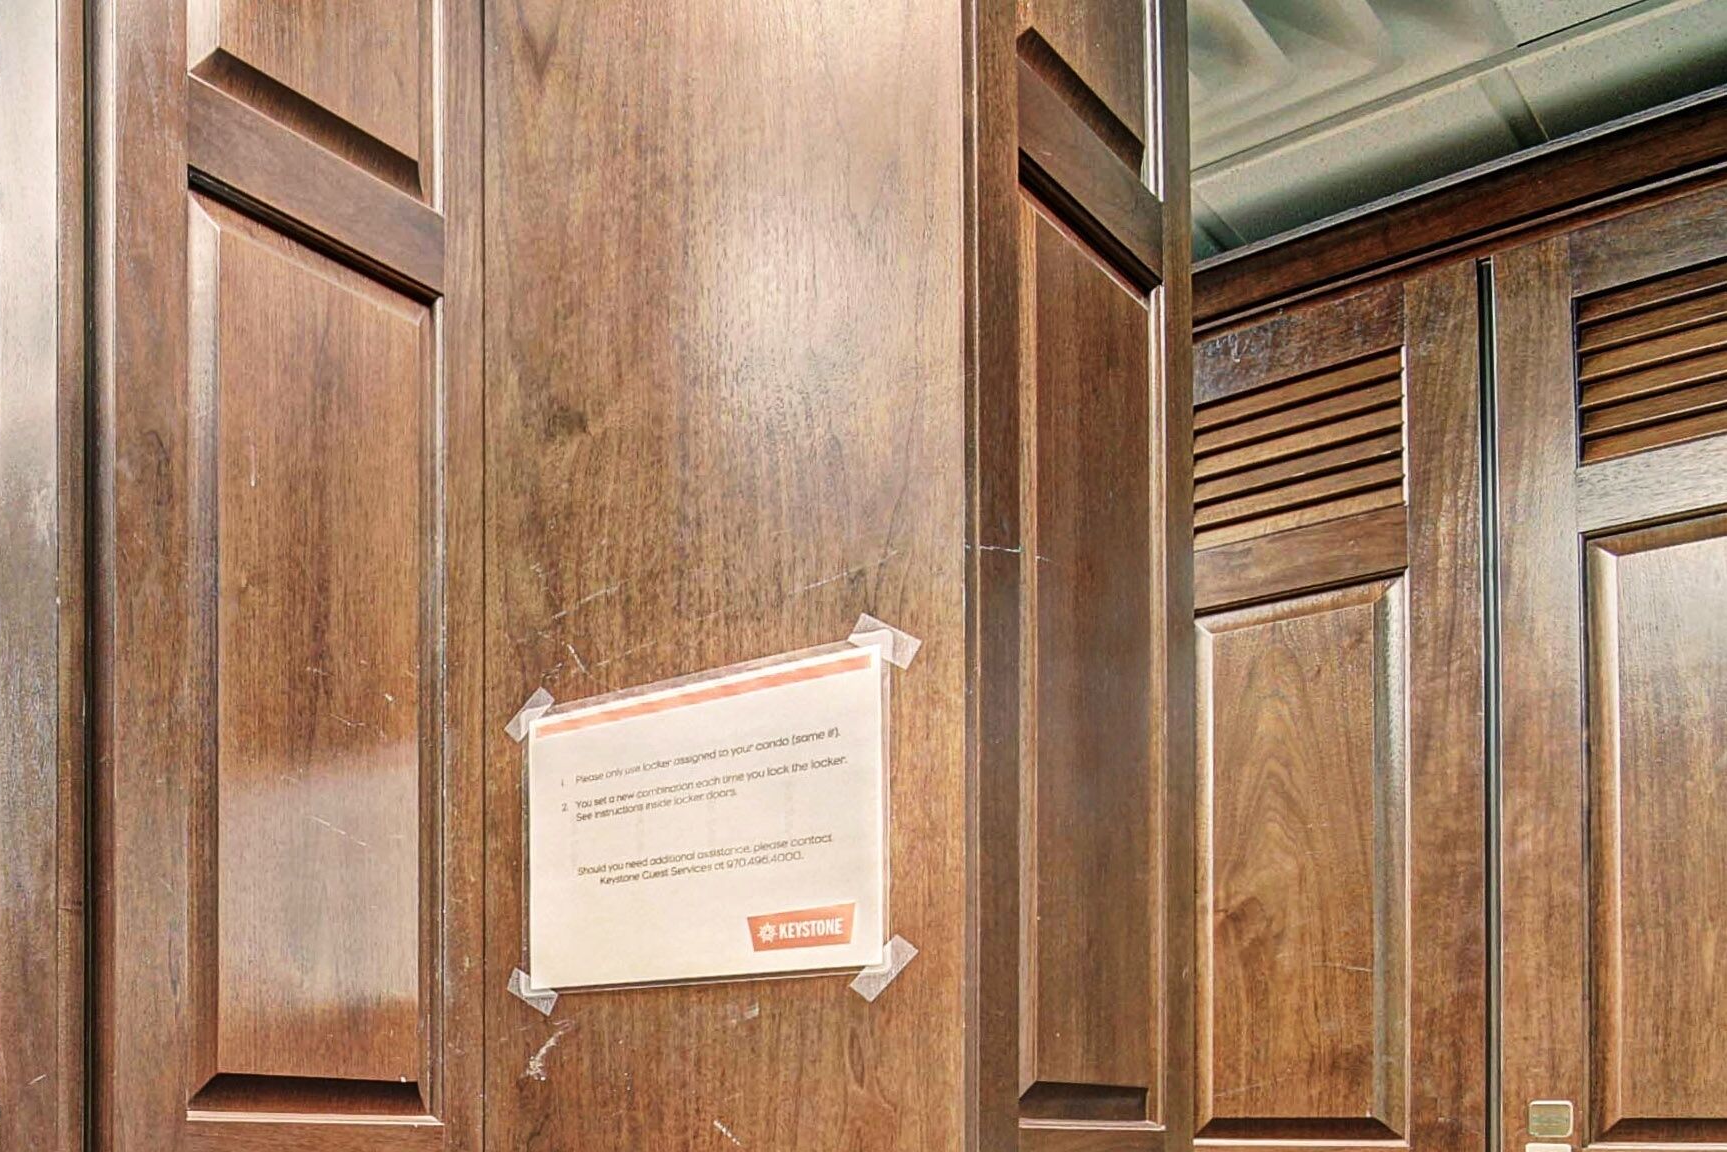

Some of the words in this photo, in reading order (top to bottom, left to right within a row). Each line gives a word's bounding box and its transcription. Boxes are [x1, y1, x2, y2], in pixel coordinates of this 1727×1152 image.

[575, 771, 604, 784] Please
[643, 760, 671, 770] locker
[674, 750, 716, 766] assigned
[719, 748, 728, 757] to
[731, 745, 753, 757] your
[755, 738, 789, 752] condo
[792, 730, 824, 746] (same
[576, 799, 592, 809] You
[594, 796, 607, 805] set
[617, 791, 633, 802] new
[636, 781, 693, 799] combination
[695, 775, 720, 788] each
[723, 772, 744, 784] time
[747, 769, 765, 782] you
[767, 765, 789, 776] lock
[792, 761, 808, 772] the
[576, 813, 593, 822] See
[595, 802, 643, 818] instructions
[646, 798, 671, 810] inside
[674, 794, 704, 805] locker
[578, 863, 606, 875] Should
[608, 862, 624, 875] you
[625, 857, 648, 868] need
[650, 851, 695, 865] additional
[754, 840, 788, 853] please
[790, 834, 833, 847] contact
[600, 872, 640, 885] Keystone
[671, 862, 712, 876] Services
[715, 862, 725, 871] at
[779, 918, 844, 939] KEYSTONE
